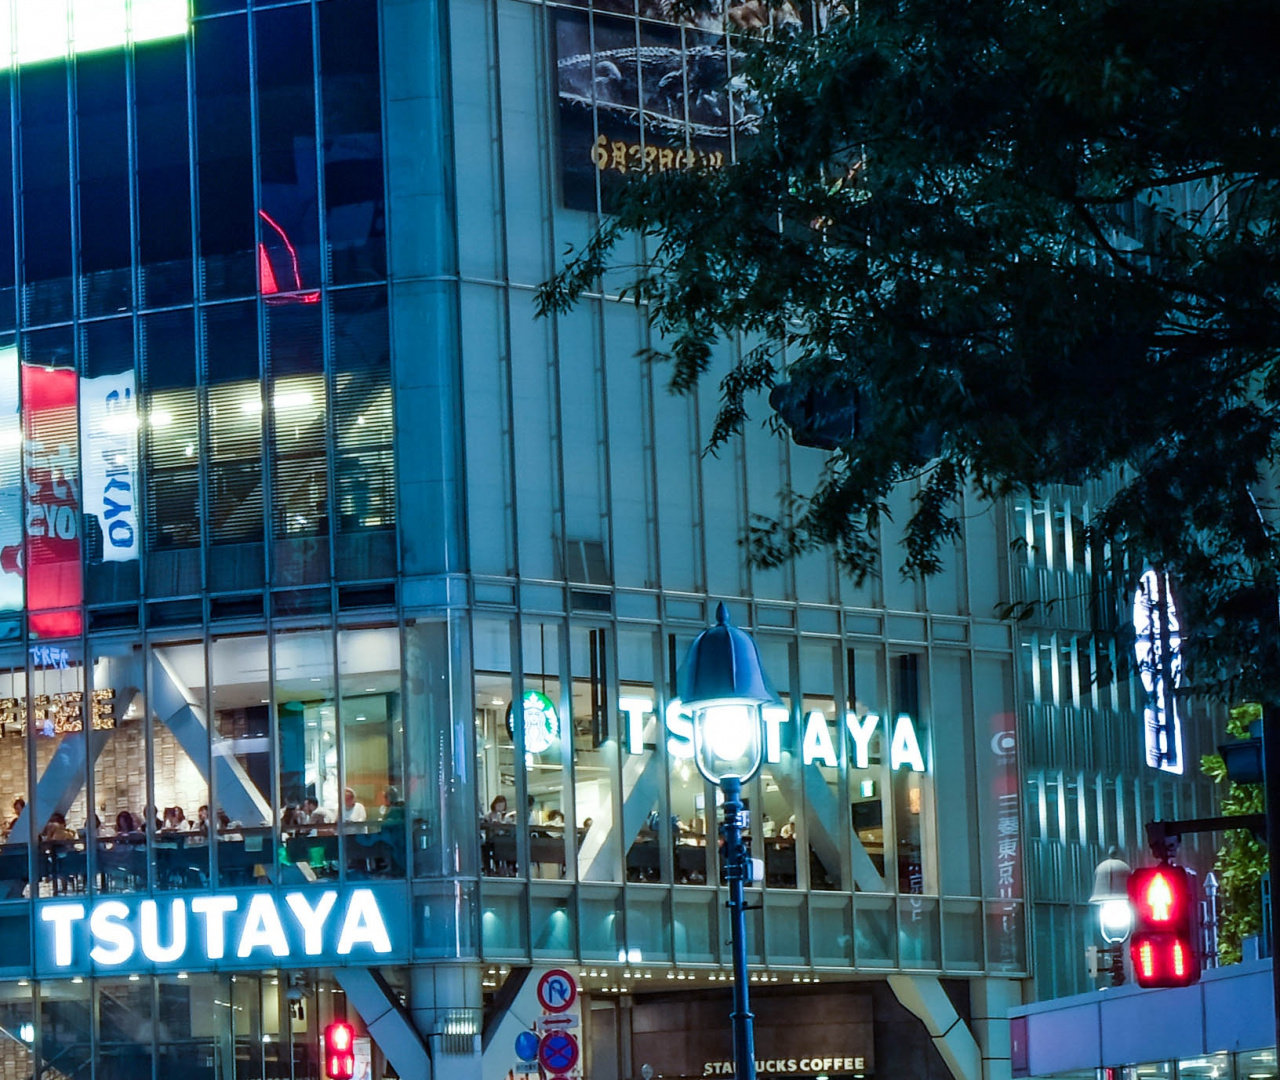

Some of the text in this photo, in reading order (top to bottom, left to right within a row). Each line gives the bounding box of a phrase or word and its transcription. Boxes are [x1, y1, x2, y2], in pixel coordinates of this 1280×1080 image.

[619, 697, 928, 773] TSTAYA
[42, 888, 393, 968] TSUTAYA
[704, 1057, 865, 1075] STAUCKS COFFEE
